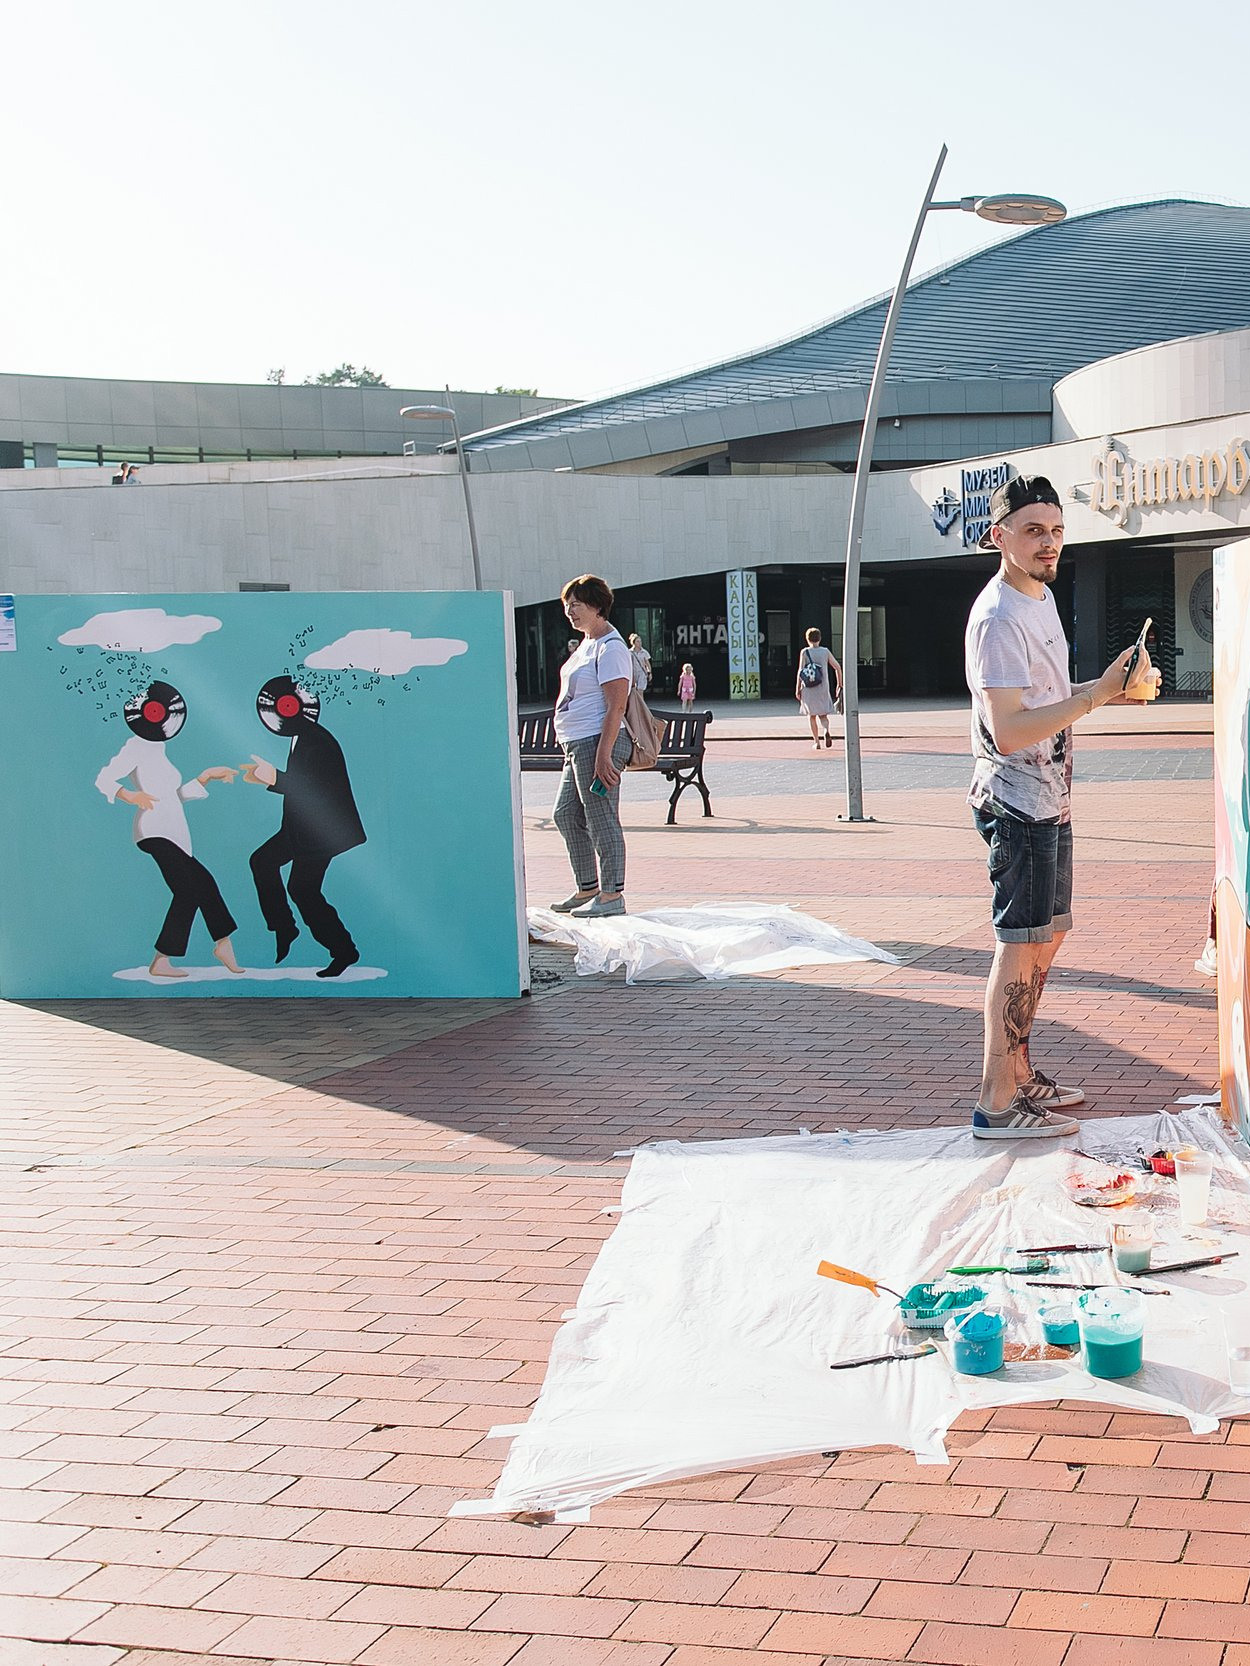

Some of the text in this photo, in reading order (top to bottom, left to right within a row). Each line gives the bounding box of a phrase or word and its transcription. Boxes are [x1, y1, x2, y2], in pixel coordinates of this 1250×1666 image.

[963, 463, 1008, 492] МУЗЕЙ
[729, 574, 742, 649] КАССЫ
[745, 573, 758, 649] КАССЫ
